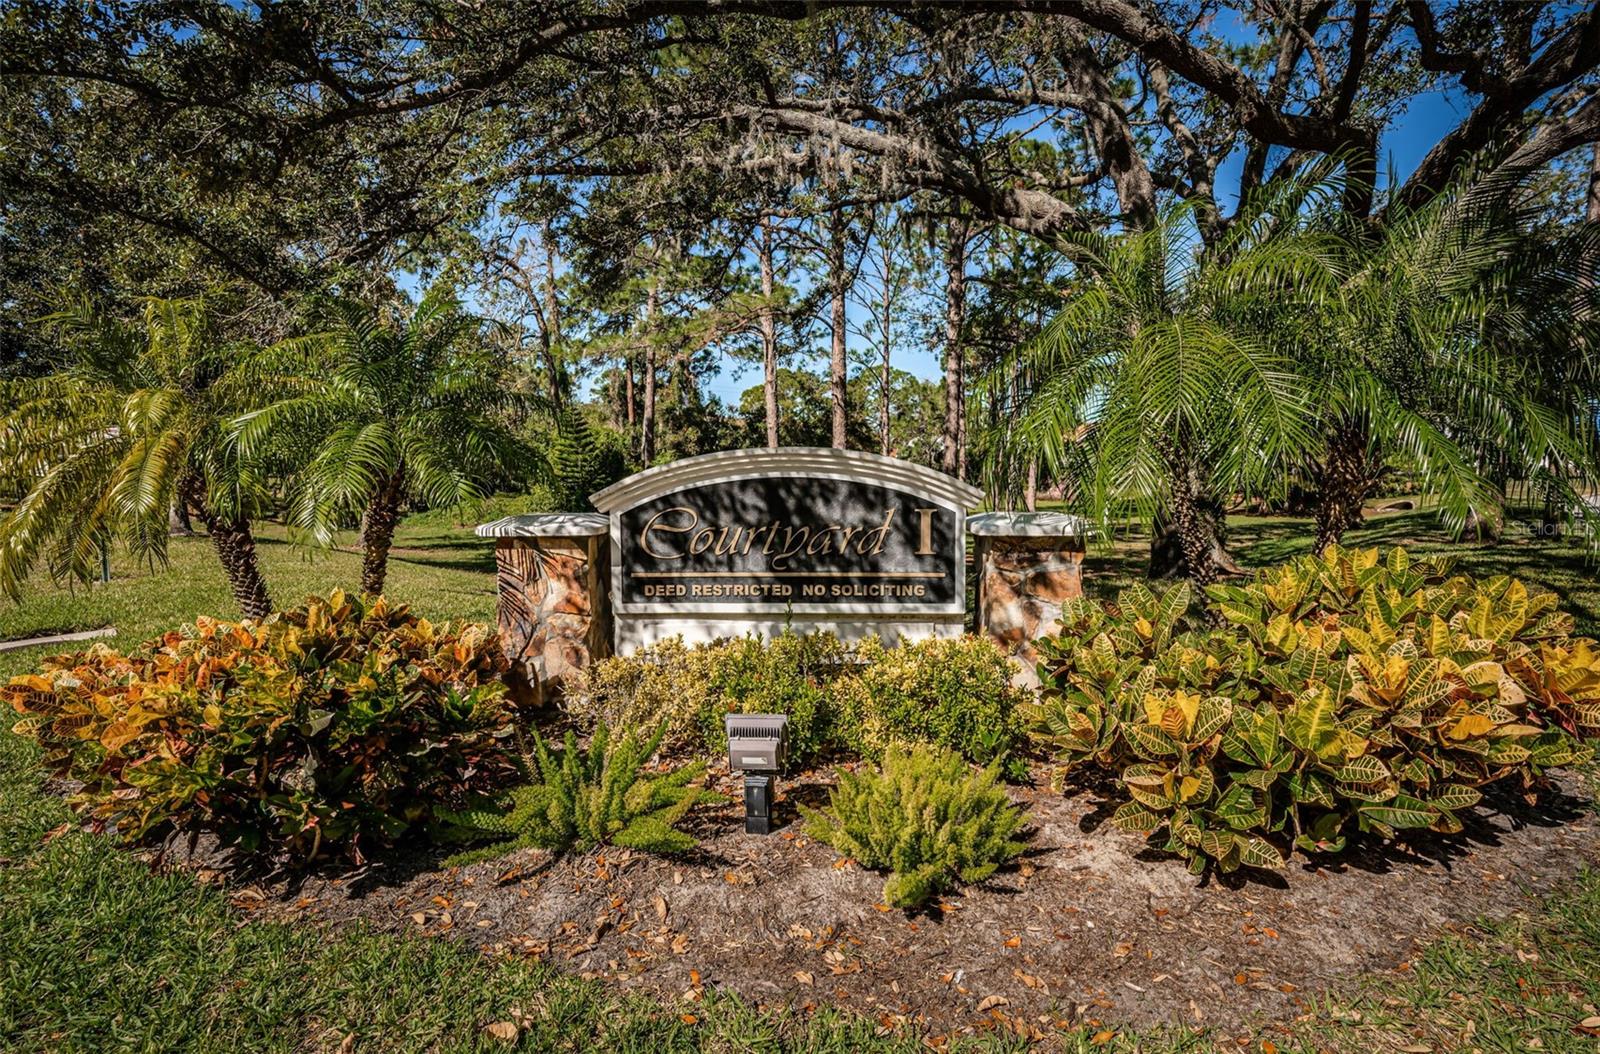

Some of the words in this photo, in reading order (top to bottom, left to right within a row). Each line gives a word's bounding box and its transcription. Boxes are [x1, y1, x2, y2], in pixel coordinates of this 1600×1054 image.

[640, 506, 896, 570] Courtyard
[644, 584, 686, 597] DEED
[692, 584, 792, 597] RESTRICTED
[802, 584, 825, 597] NO
[831, 584, 925, 597] SOLICITING
